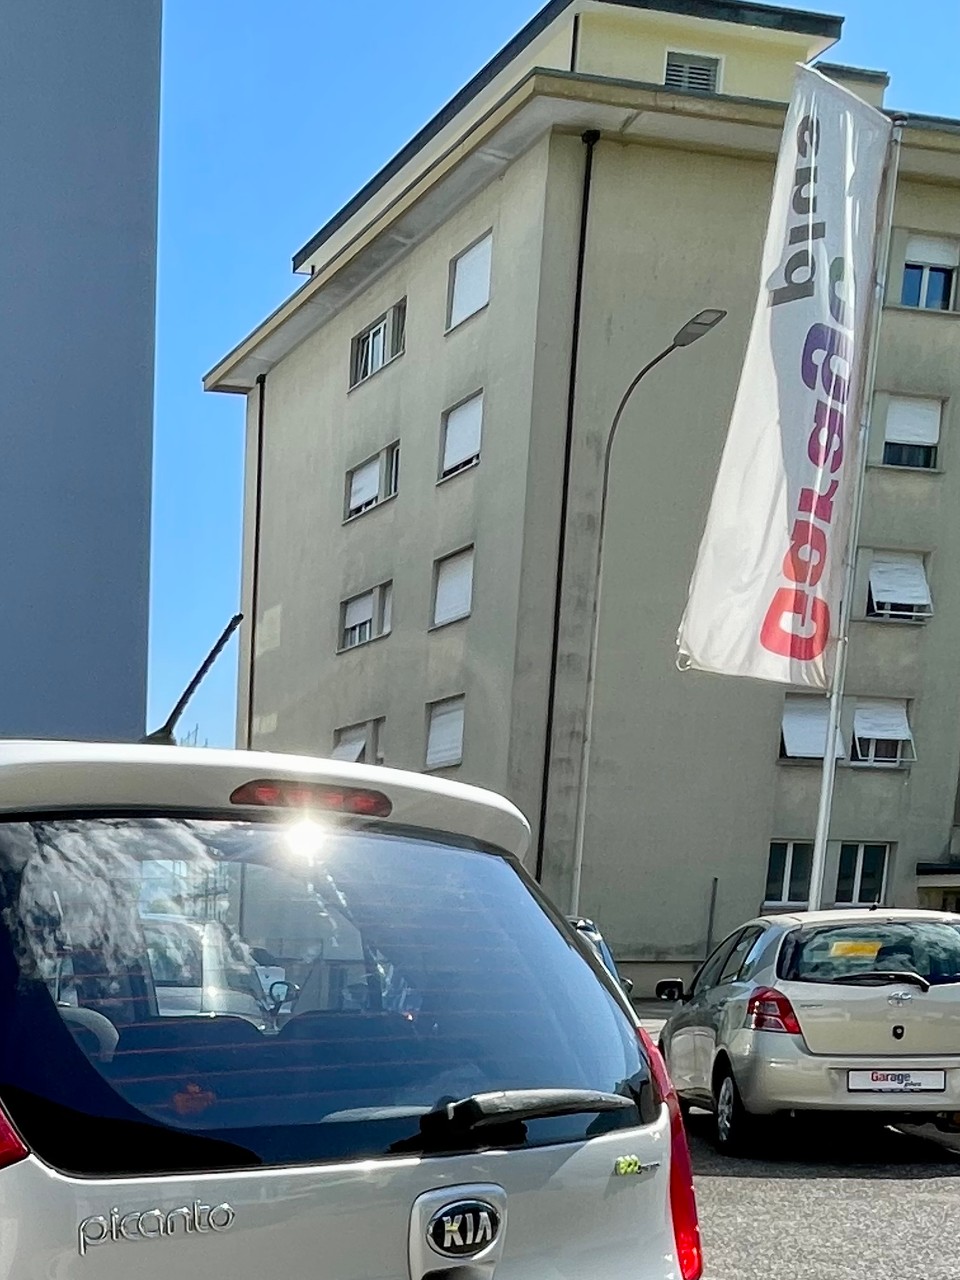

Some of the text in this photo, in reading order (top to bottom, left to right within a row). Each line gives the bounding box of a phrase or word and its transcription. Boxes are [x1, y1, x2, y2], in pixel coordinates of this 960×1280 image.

[871, 1071, 910, 1084] Garage
[78, 1199, 236, 1257] picanto
[442, 1211, 492, 1248] KIA
